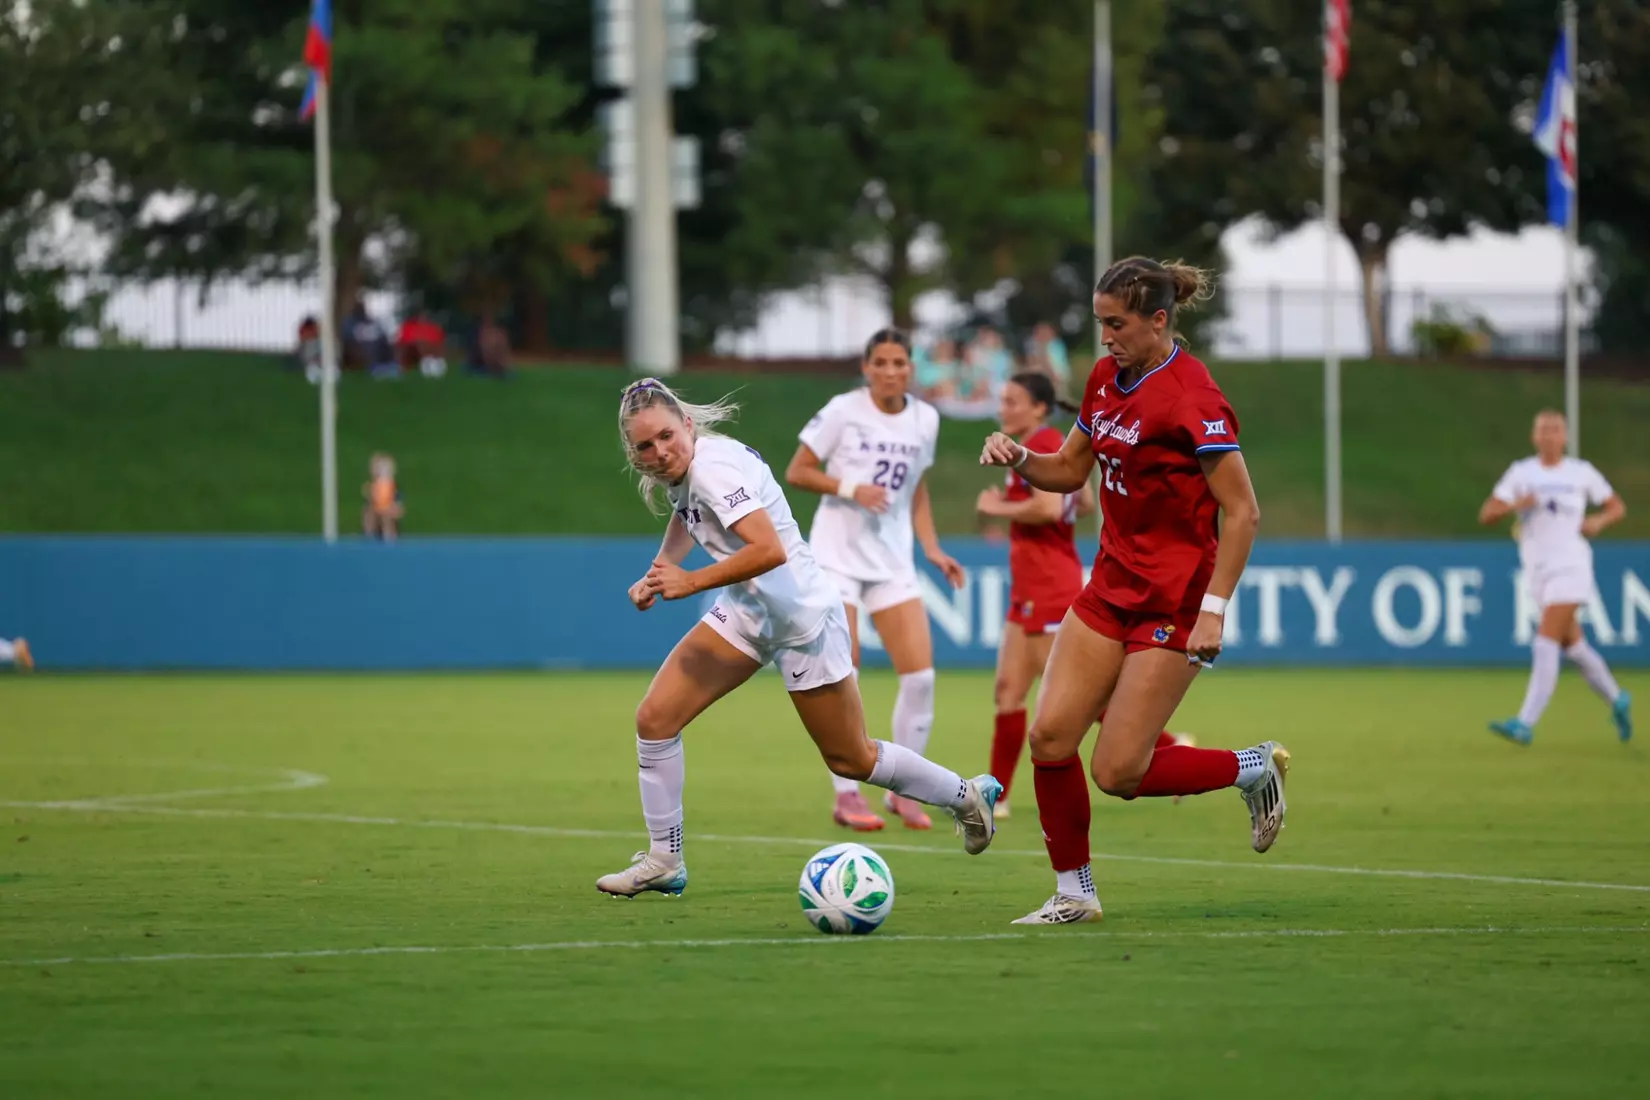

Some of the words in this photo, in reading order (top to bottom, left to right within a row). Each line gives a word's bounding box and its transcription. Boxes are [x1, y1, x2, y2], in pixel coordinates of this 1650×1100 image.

[1090, 410, 1141, 446] Jayhawks
[872, 459, 908, 491] 28
[1371, 564, 1483, 648] OF
